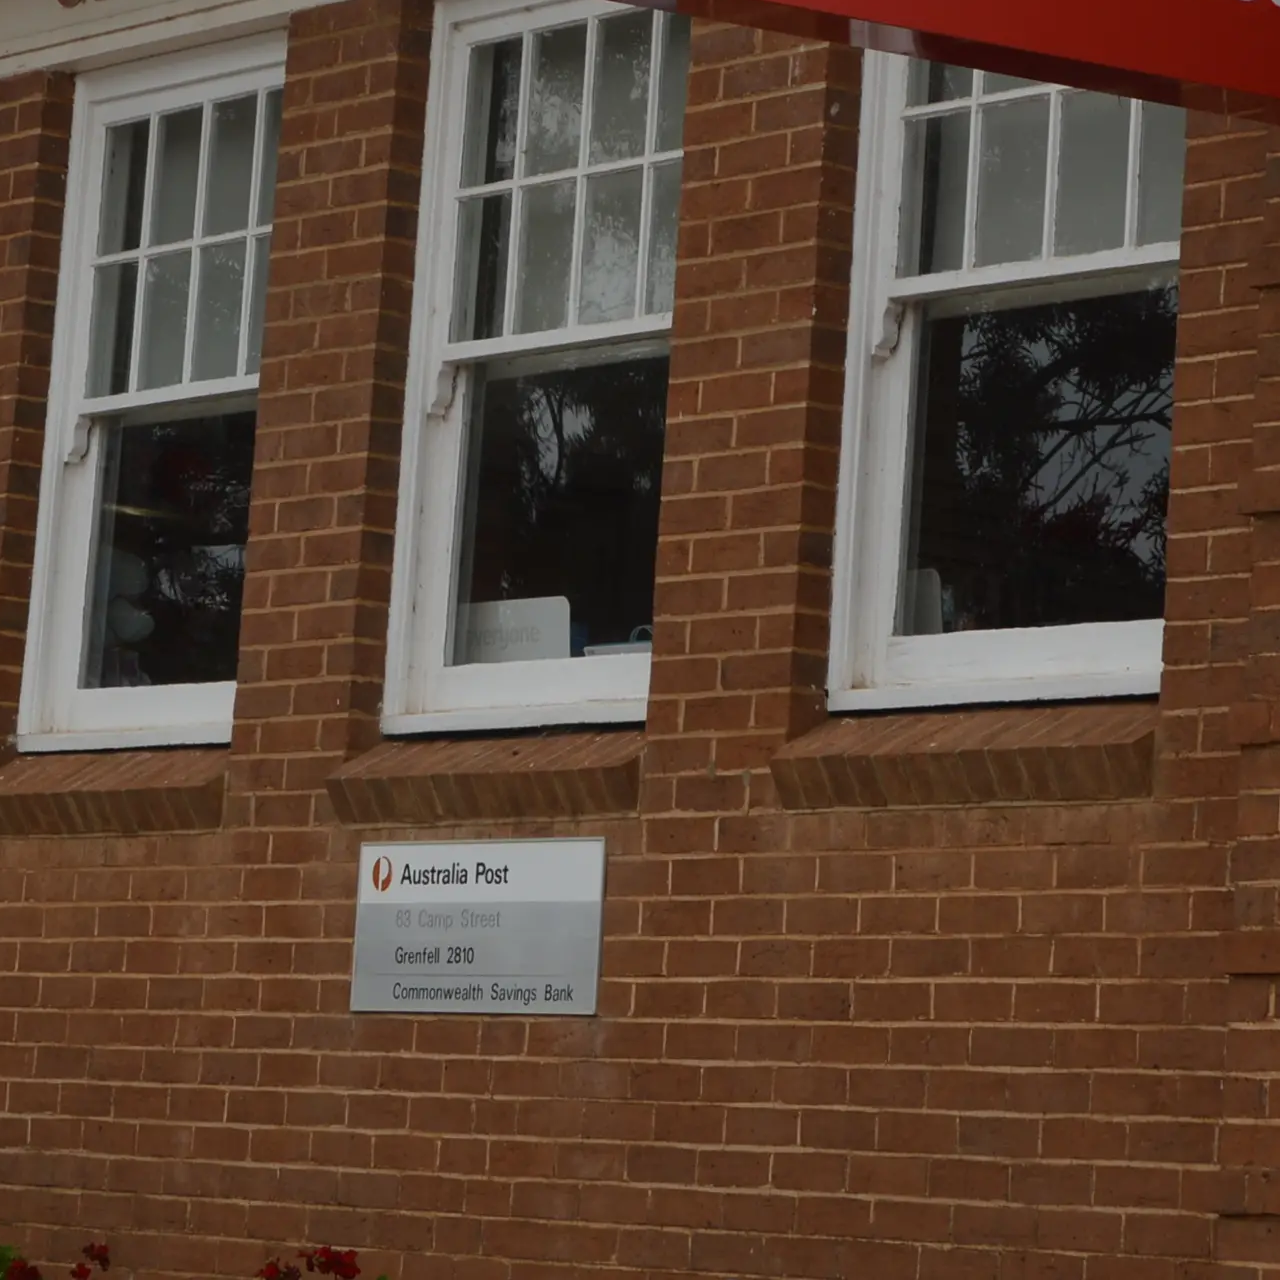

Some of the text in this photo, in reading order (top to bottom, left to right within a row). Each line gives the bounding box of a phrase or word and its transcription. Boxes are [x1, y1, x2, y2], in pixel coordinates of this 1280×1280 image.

[400, 862, 510, 886] Australia Post
[418, 909, 454, 931] Camp
[460, 908, 501, 929] Street
[394, 946, 475, 965] Grenfell 2810
[392, 982, 574, 1005] Commonwealth Savings Bank
